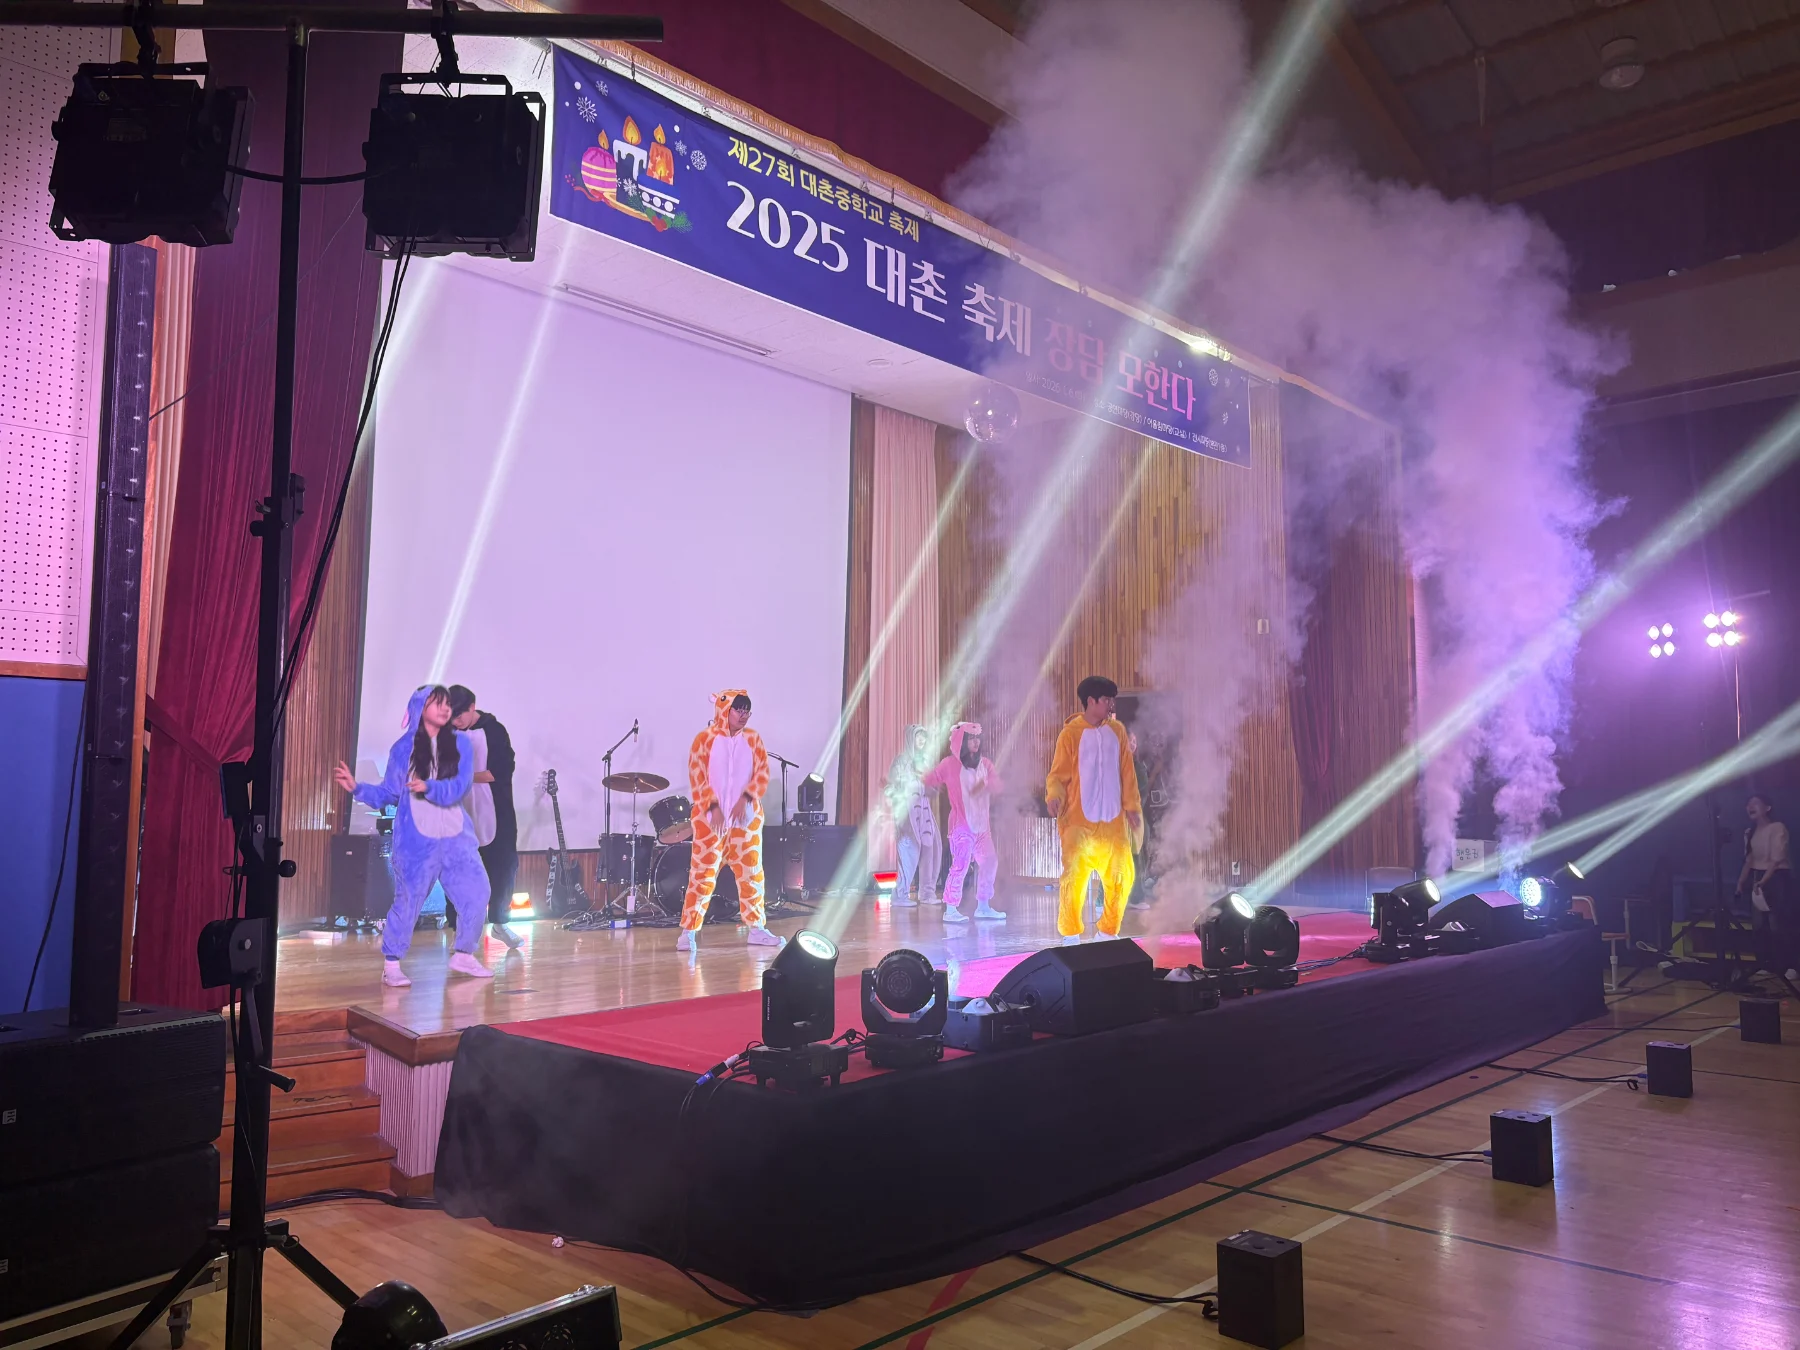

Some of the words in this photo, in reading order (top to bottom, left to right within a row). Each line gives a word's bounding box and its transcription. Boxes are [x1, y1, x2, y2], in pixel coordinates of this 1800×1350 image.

[727, 136, 795, 187] 제27회
[800, 169, 884, 226] 대촌중학교
[887, 210, 920, 243] 축제
[727, 180, 849, 273] 2025
[863, 237, 948, 324] 대촌
[961, 282, 1032, 357] 축제
[1045, 316, 1108, 386] 장담
[1116, 349, 1197, 421] 모한다
[1455, 847, 1479, 861] 행운권
